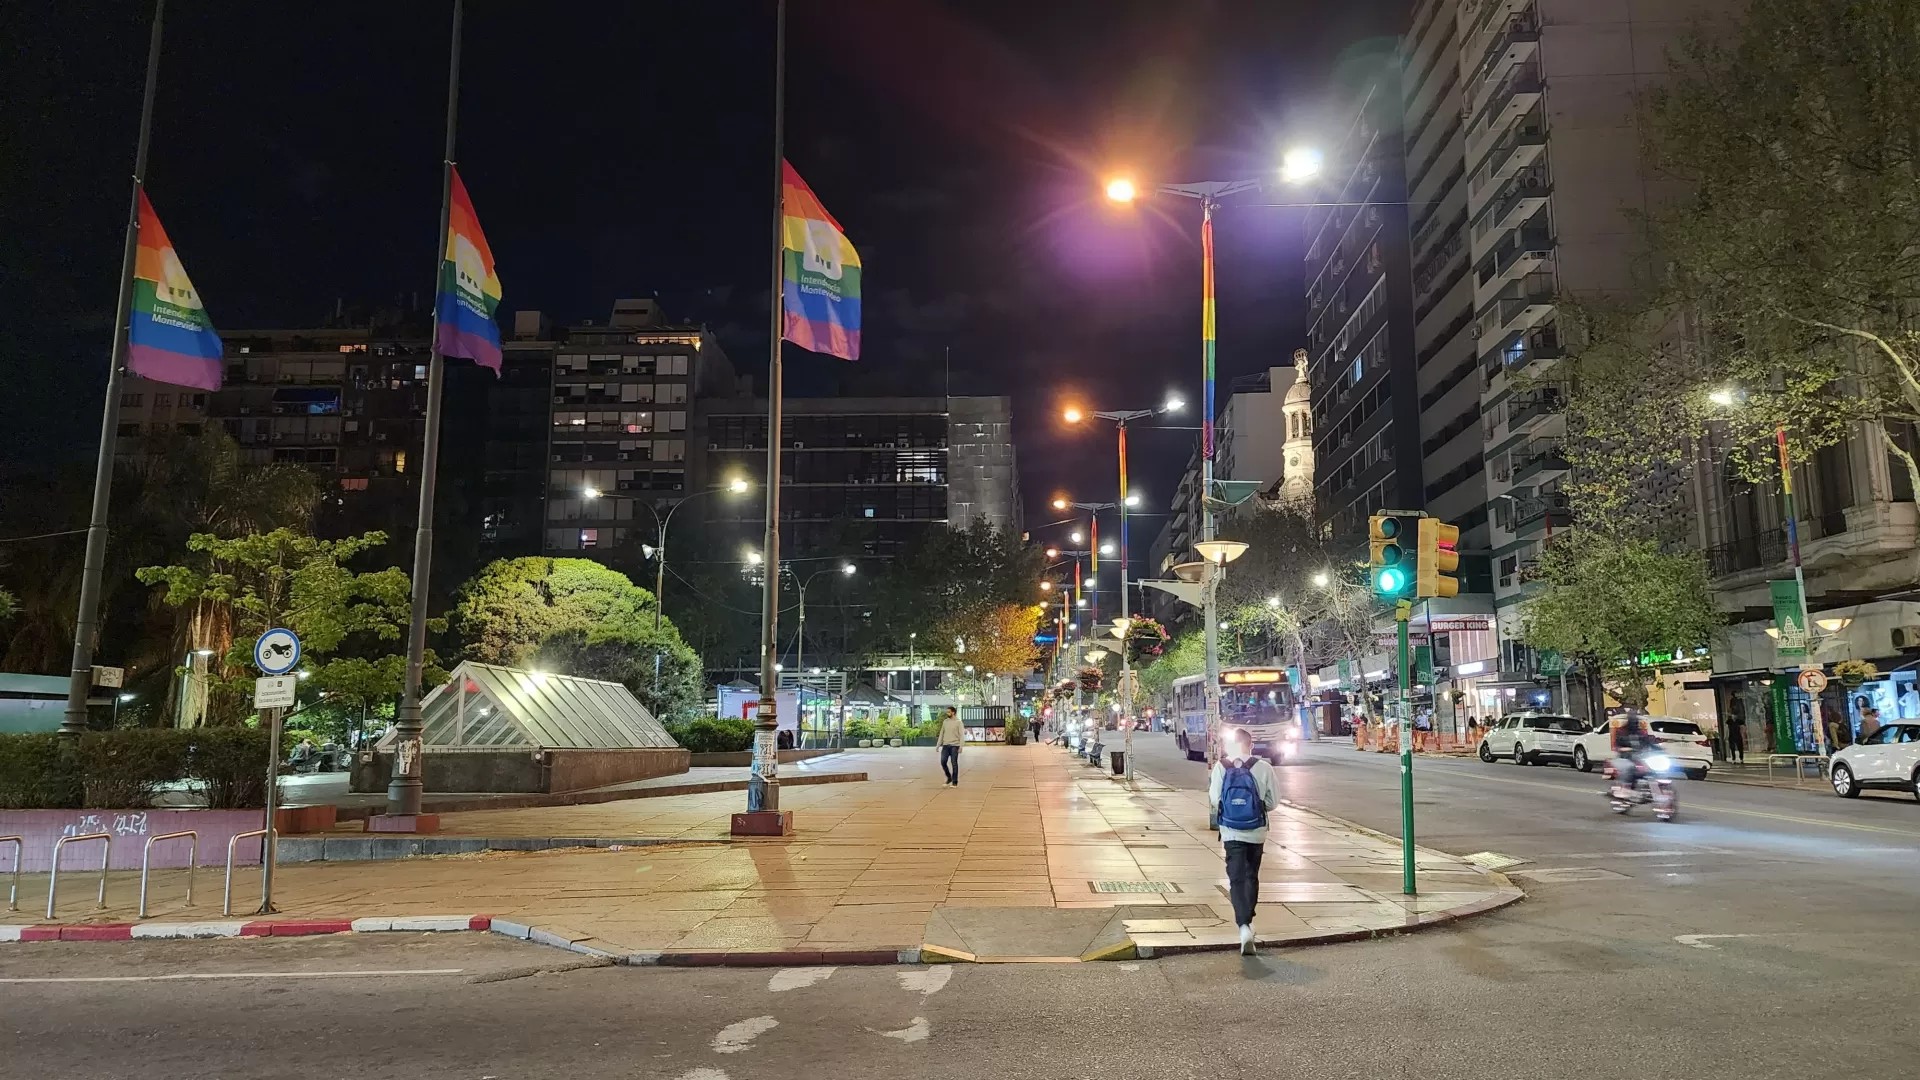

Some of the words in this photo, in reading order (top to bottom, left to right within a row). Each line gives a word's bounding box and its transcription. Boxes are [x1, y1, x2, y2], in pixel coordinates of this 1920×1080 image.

[800, 284, 842, 302] Montevideo
[151, 313, 203, 332] Montevideo
[1431, 621, 1465, 630] BURGER
[1466, 621, 1488, 630] KING
